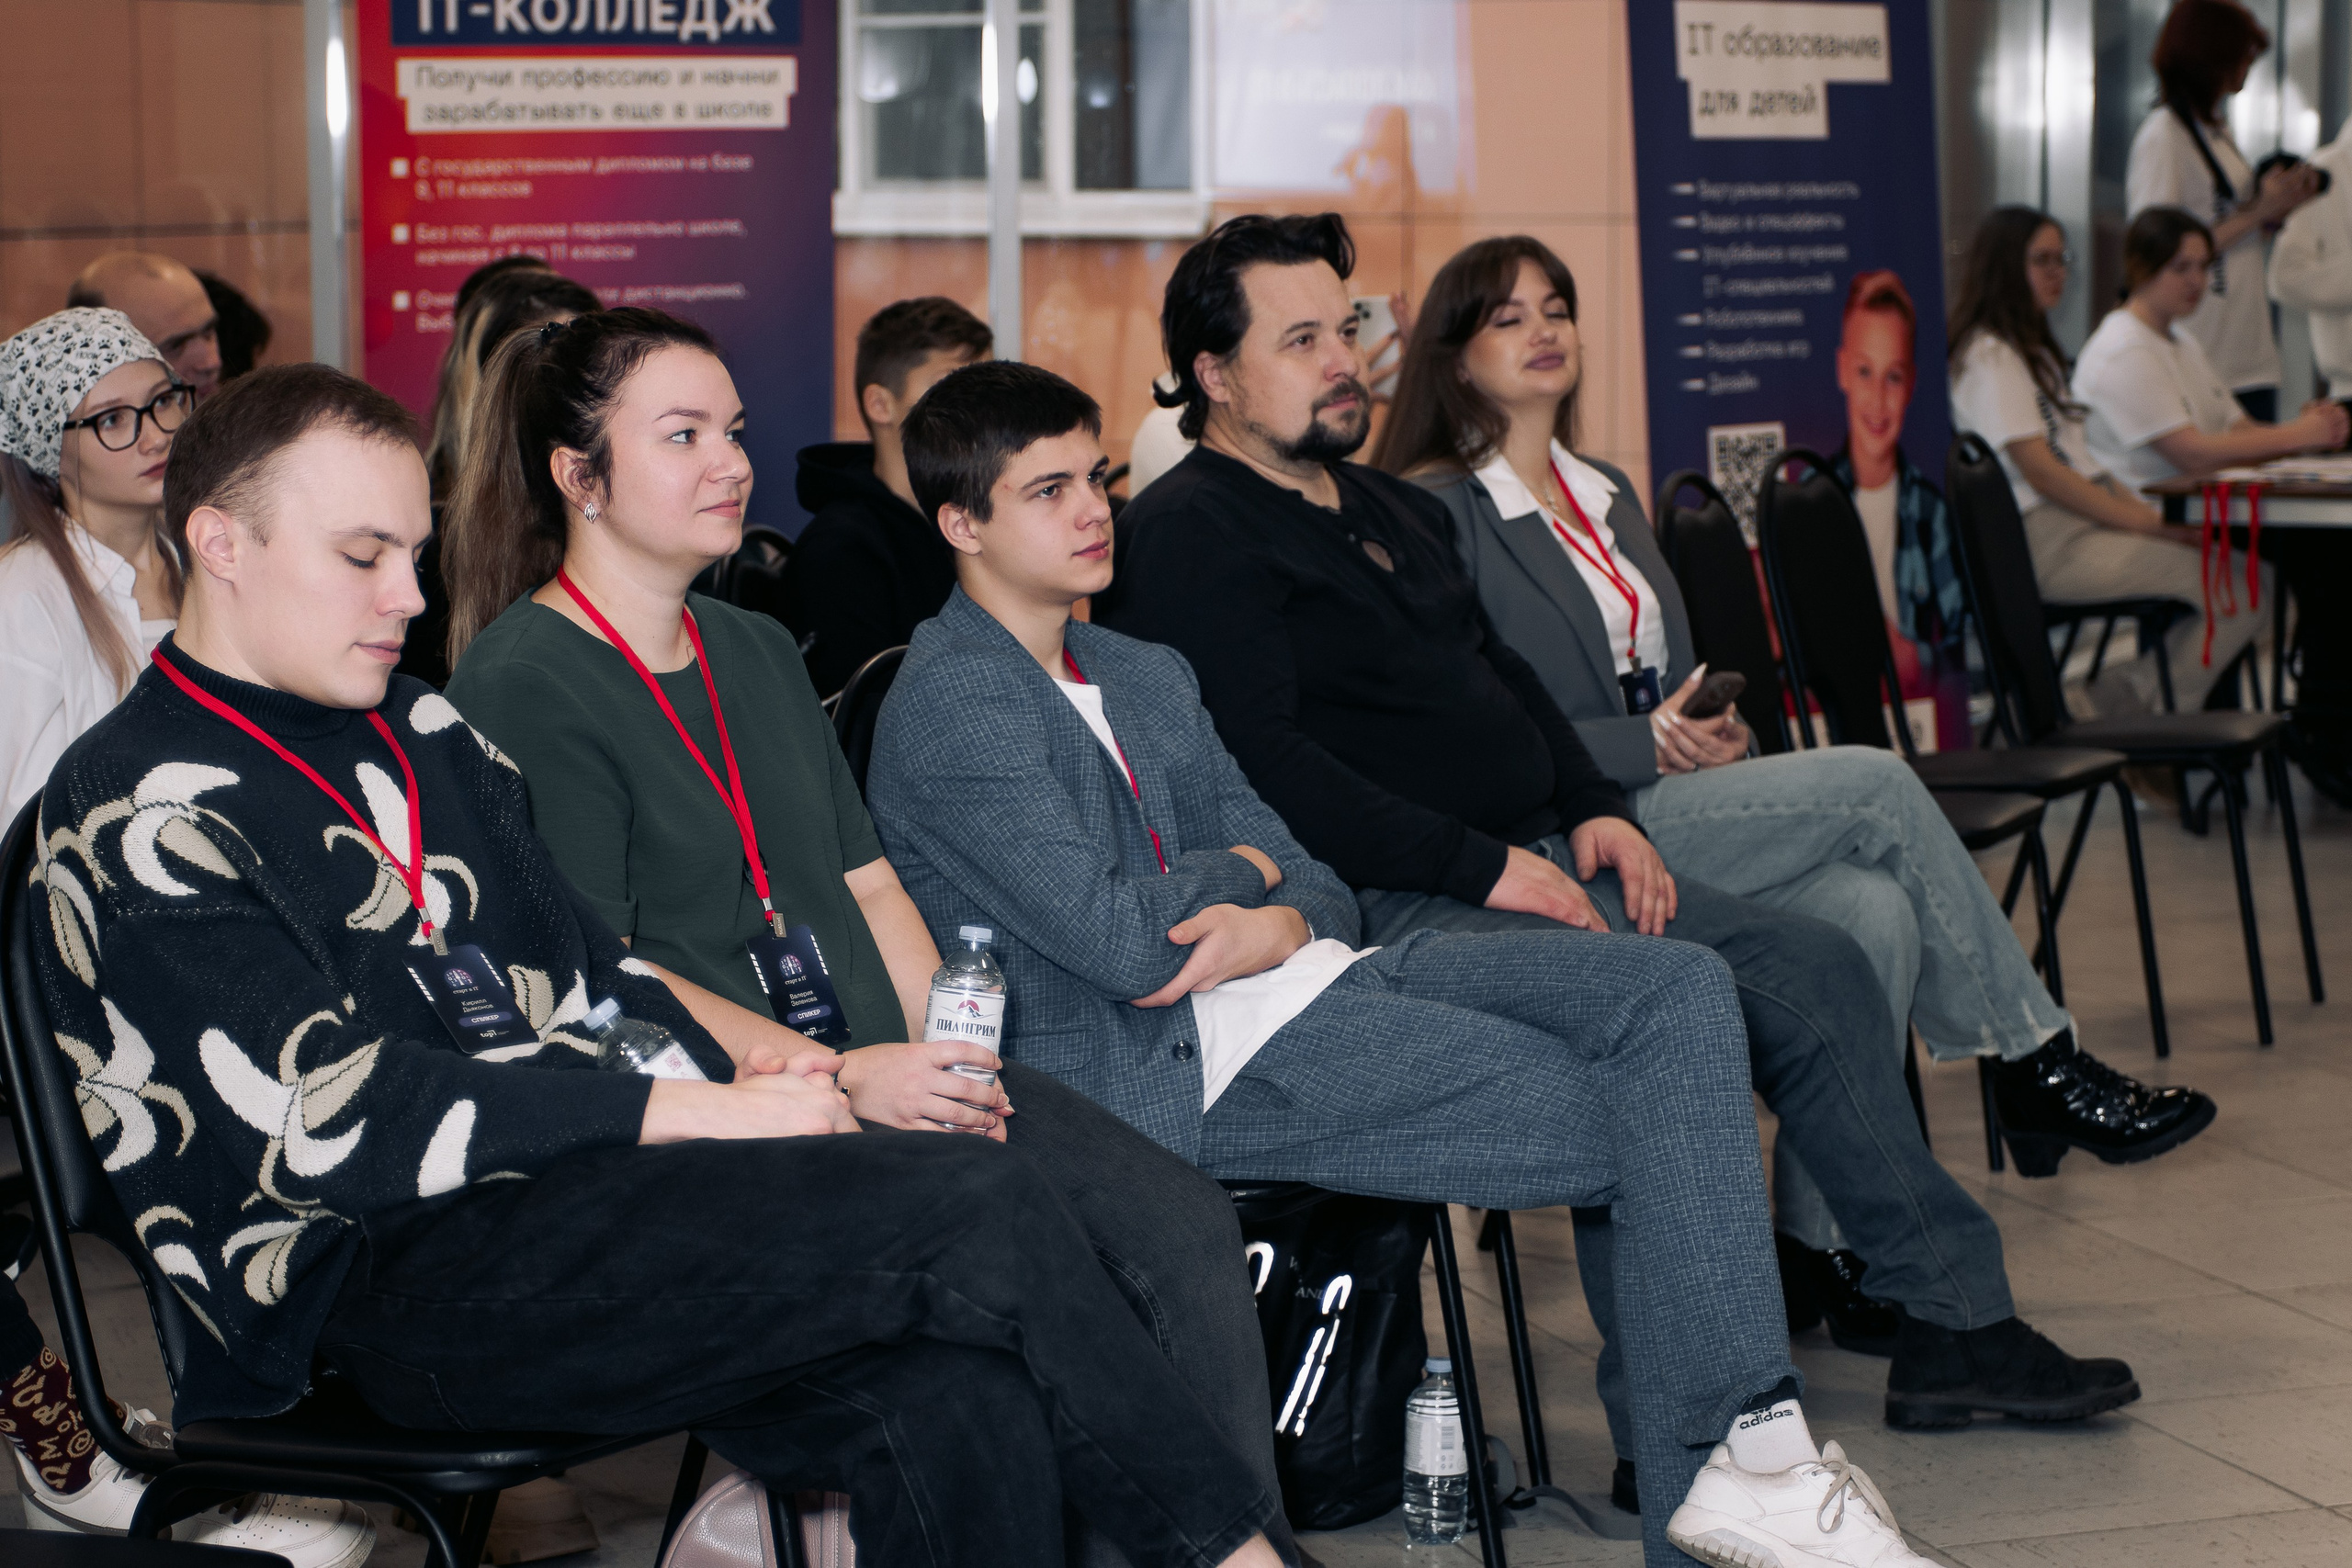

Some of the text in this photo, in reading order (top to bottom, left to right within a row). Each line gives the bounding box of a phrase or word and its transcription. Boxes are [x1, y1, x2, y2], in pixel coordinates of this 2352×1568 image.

[1723, 26, 1883, 61] образование
[416, 64, 780, 90] Получи профессию и начни
[1699, 85, 1816, 118] для детей
[424, 97, 603, 125] зарабатывать
[674, 104, 686, 118] в
[696, 102, 773, 119] школе
[789, 989, 814, 1000] Валерия
[791, 996, 818, 1007] Зеленова
[461, 998, 487, 1007] Кирилл
[463, 1004, 494, 1013] Дьяконов
[470, 1014, 500, 1023] СПИКЕР
[797, 1009, 820, 1020] СПИКЕР
[936, 1018, 997, 1038] ПИЛИГРИМ
[1739, 1409, 1794, 1429] adidas
